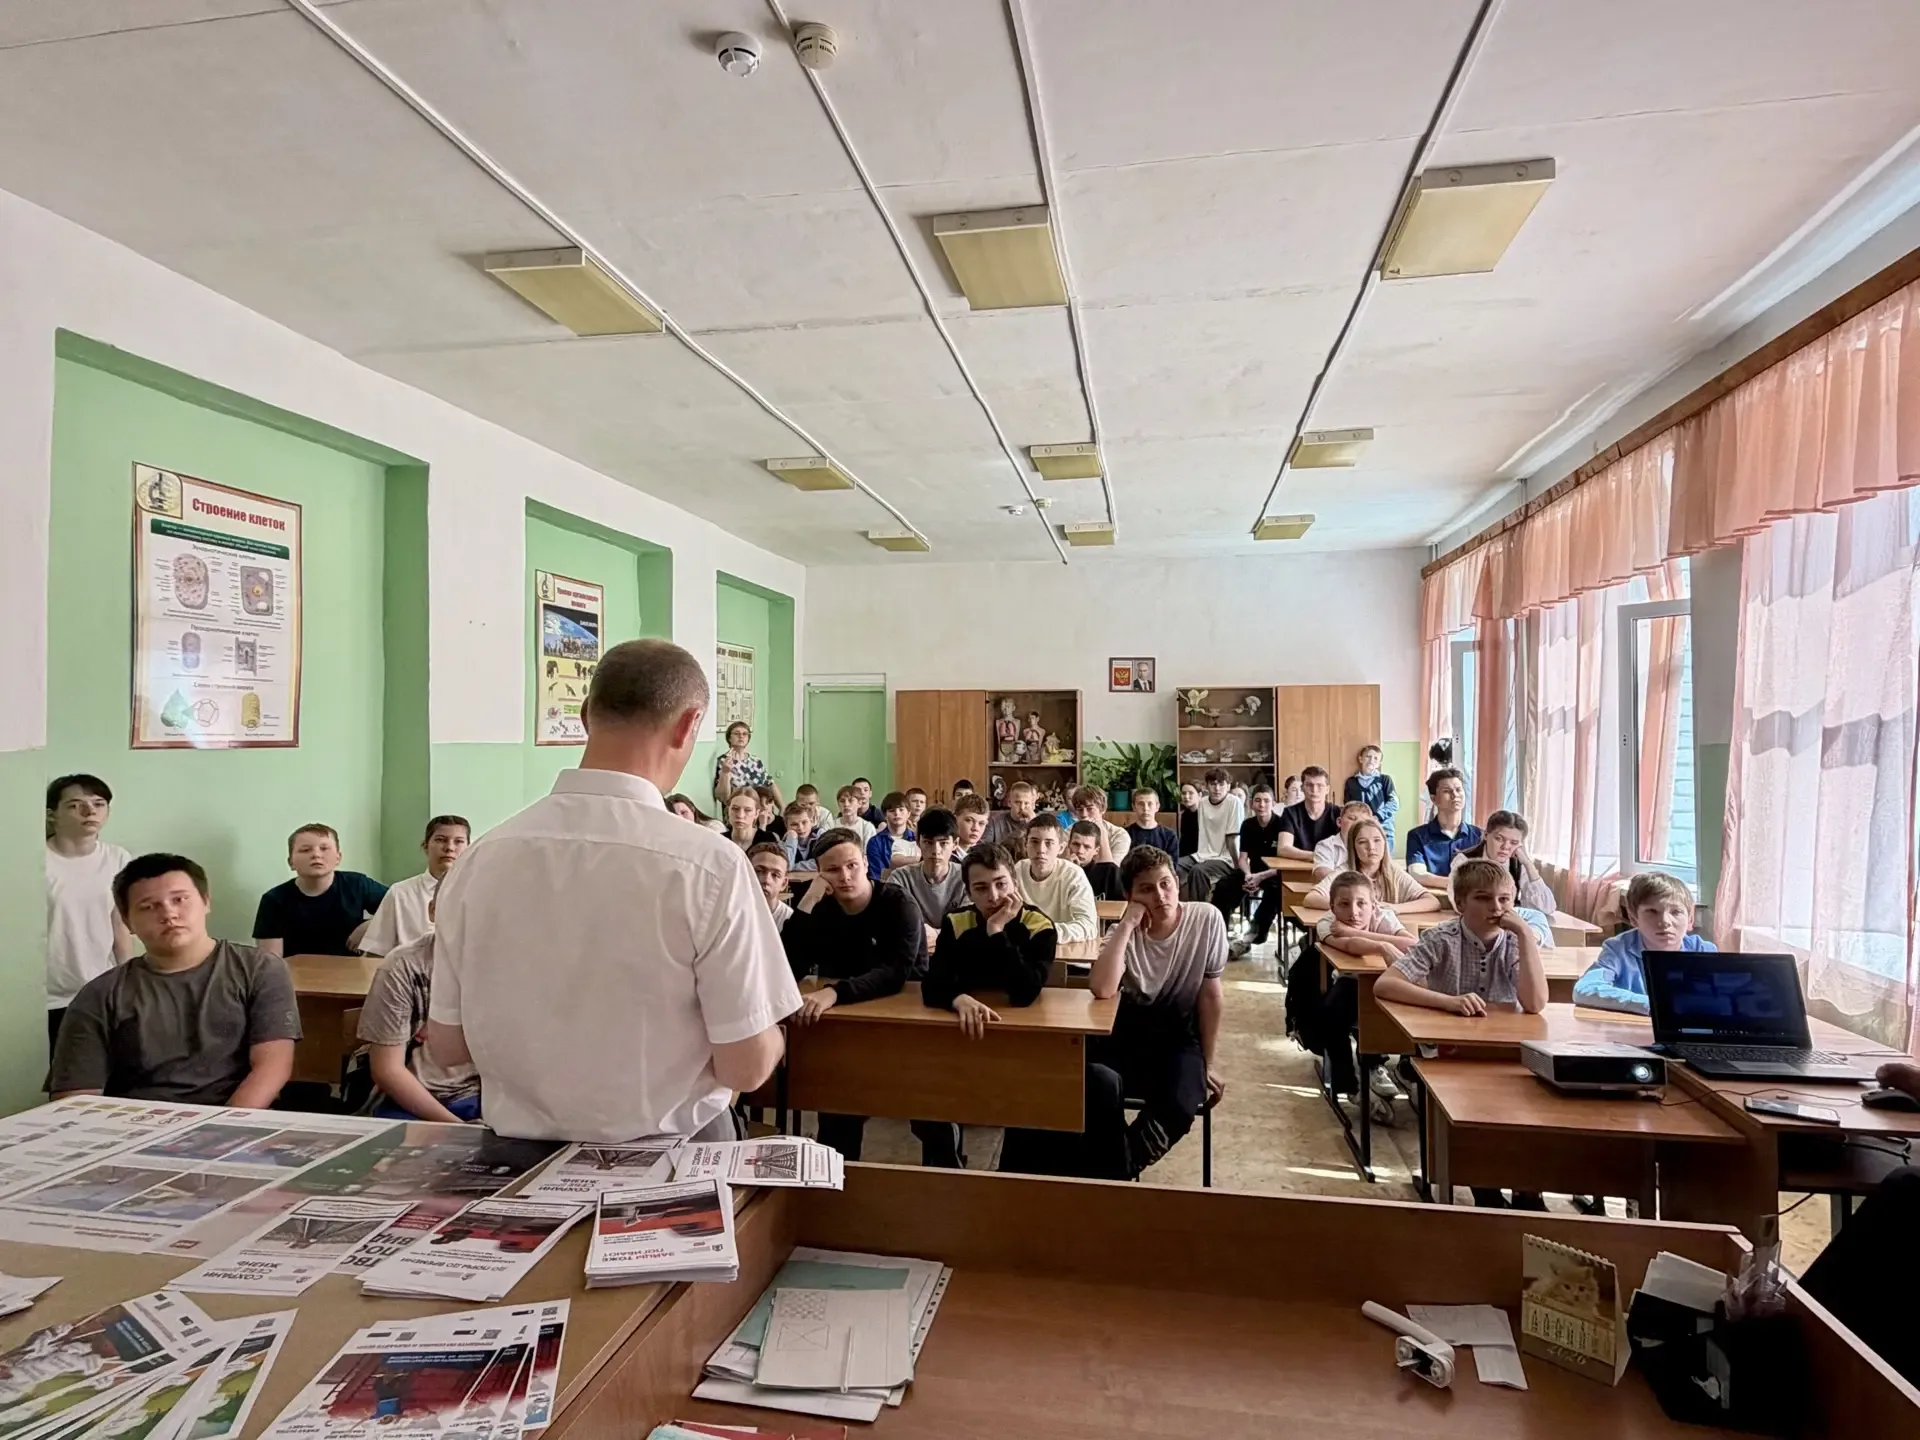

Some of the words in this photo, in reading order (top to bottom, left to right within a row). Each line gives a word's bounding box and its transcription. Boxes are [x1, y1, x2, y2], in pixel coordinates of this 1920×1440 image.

[192, 497, 247, 522] Строение
[248, 513, 286, 531] клеток
[602, 1248, 664, 1257] ПОГИБАЮТ
[635, 1252, 675, 1260] ЗАЙЦЫ
[236, 1260, 282, 1269] ЖИЗНЬ
[400, 1258, 446, 1267] ВРЕМЕНИ
[462, 1263, 490, 1271] ПОРЫ
[202, 1271, 264, 1281] СОХРАНИ
